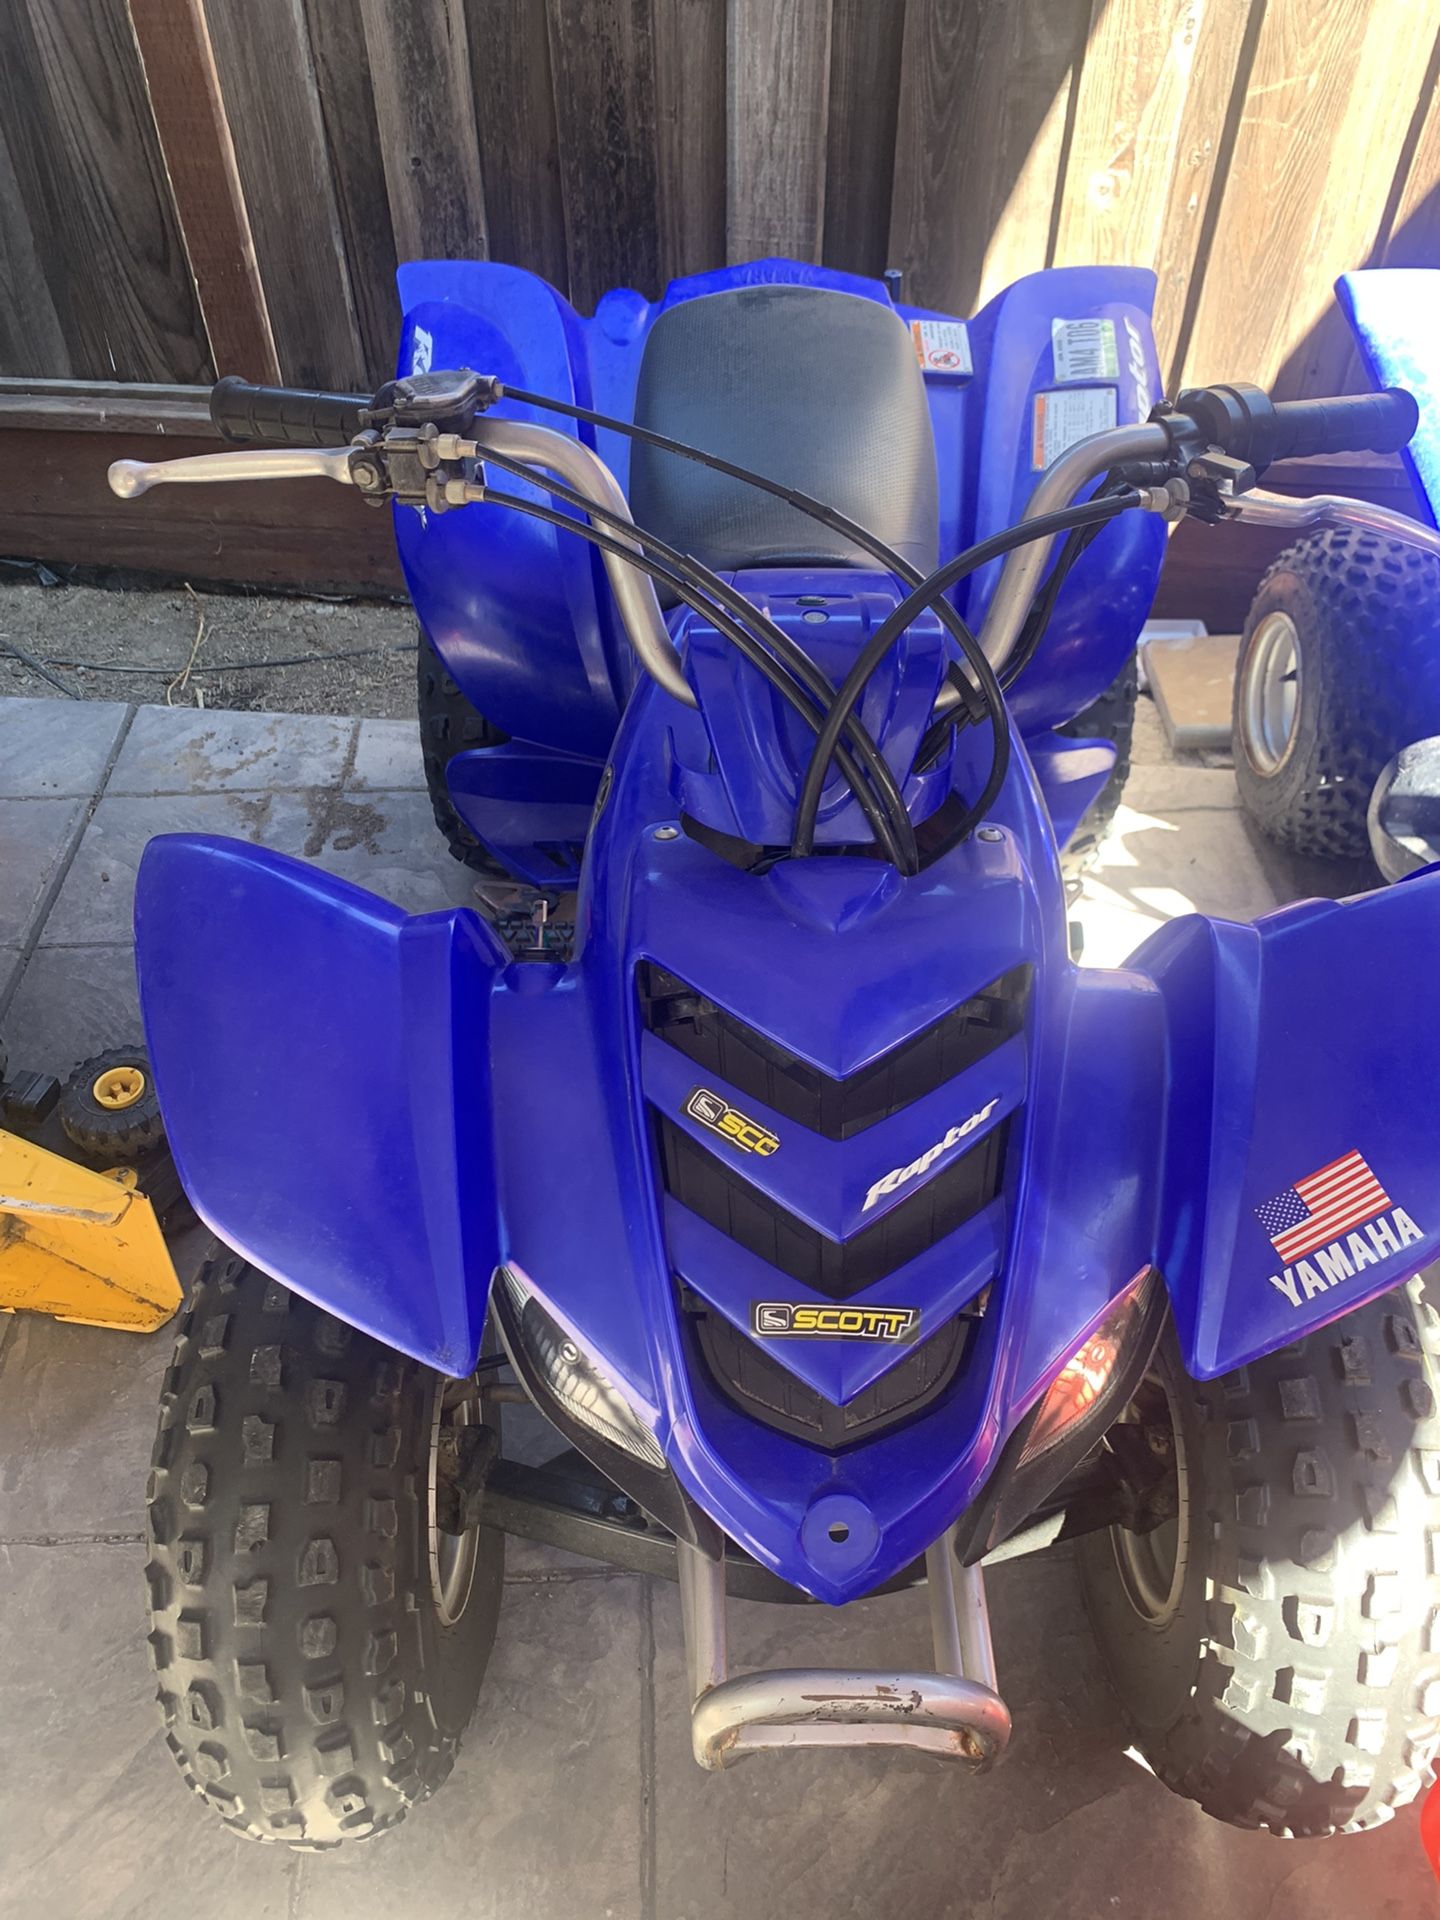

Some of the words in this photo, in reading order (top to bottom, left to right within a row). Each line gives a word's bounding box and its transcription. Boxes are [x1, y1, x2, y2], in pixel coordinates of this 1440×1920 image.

[861, 1097, 1000, 1212] Raptor
[1269, 1207, 1425, 1307] YAMAHA
[793, 1310, 906, 1333] SCOTT
